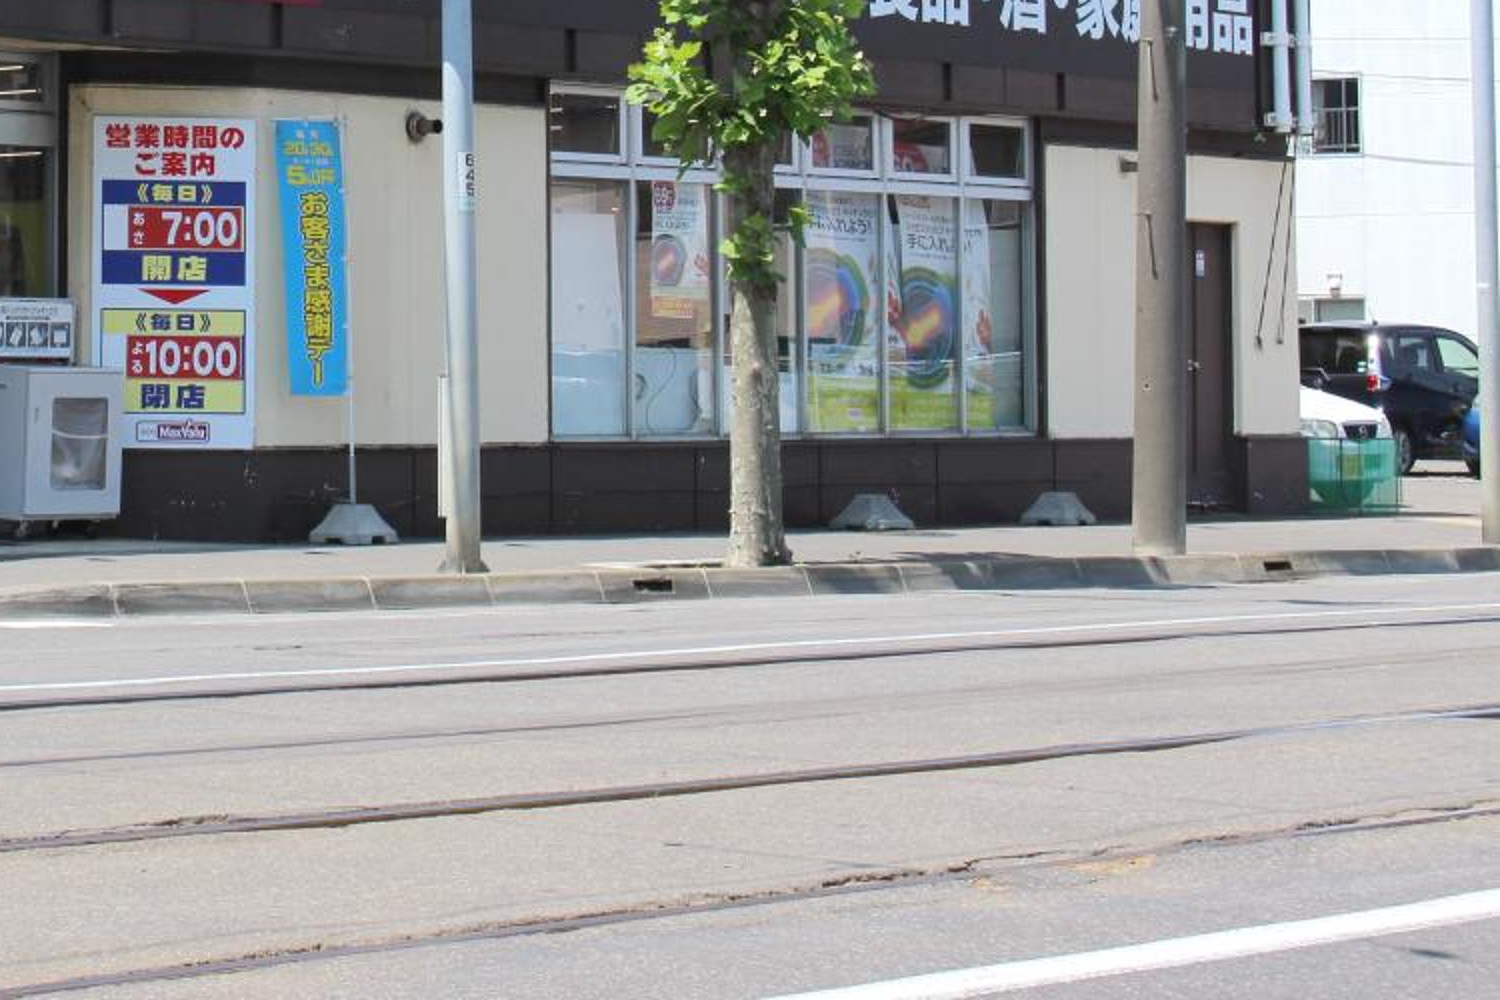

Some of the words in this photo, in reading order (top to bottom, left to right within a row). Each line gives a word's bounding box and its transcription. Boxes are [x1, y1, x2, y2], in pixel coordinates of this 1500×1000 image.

[105, 123, 245, 149] 営業時間の
[135, 152, 216, 176] ご案内
[133, 212, 145, 245] あさ
[161, 211, 238, 247] 7:00
[142, 255, 207, 281] 開店
[300, 191, 333, 386] お客さま感謝デー
[132, 341, 143, 374] よる
[146, 340, 237, 376] 10:00
[141, 384, 205, 408] 閉店
